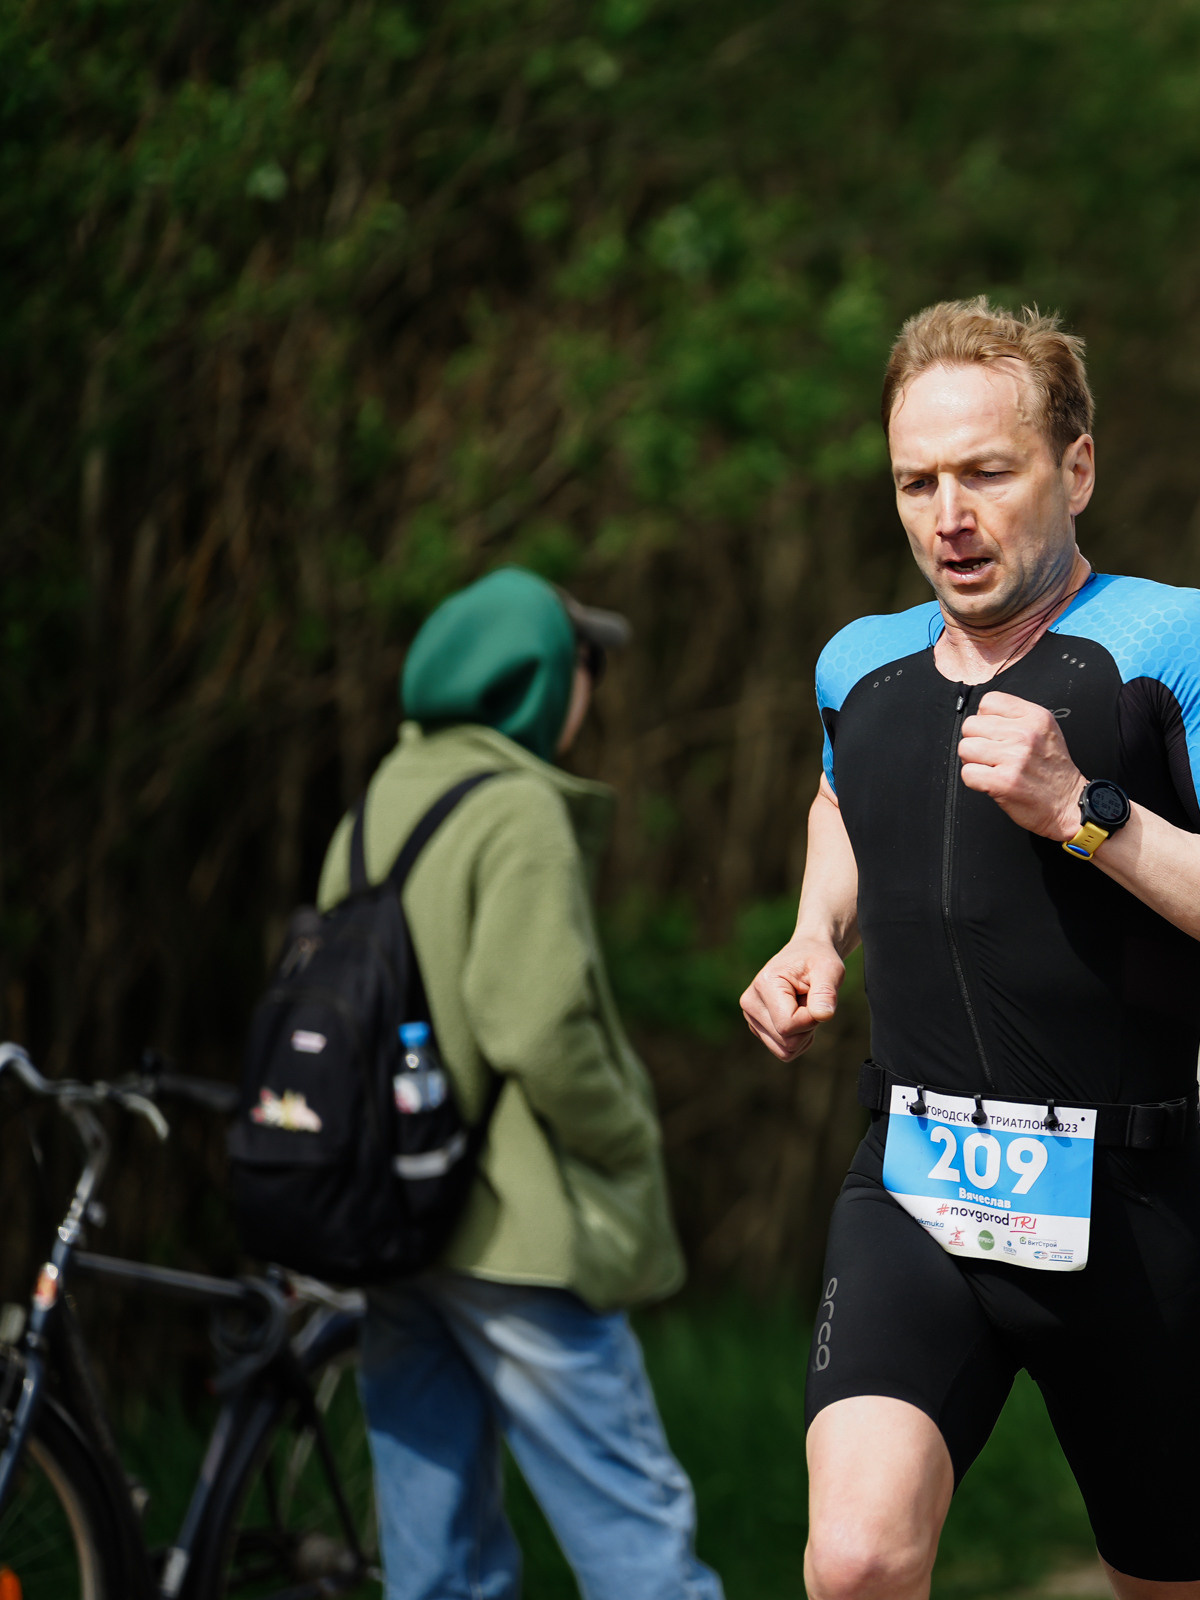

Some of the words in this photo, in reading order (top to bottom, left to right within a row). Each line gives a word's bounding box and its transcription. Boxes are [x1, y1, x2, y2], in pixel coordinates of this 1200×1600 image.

[905, 1101, 985, 1123] НГОРОДСК
[989, 1115, 1048, 1131] ТРИАТЛОН
[1052, 1122, 1078, 1133] 023
[927, 1125, 1048, 1195] 209
[958, 1187, 1012, 1209] Вячеслав
[815, 1277, 838, 1372] orca
